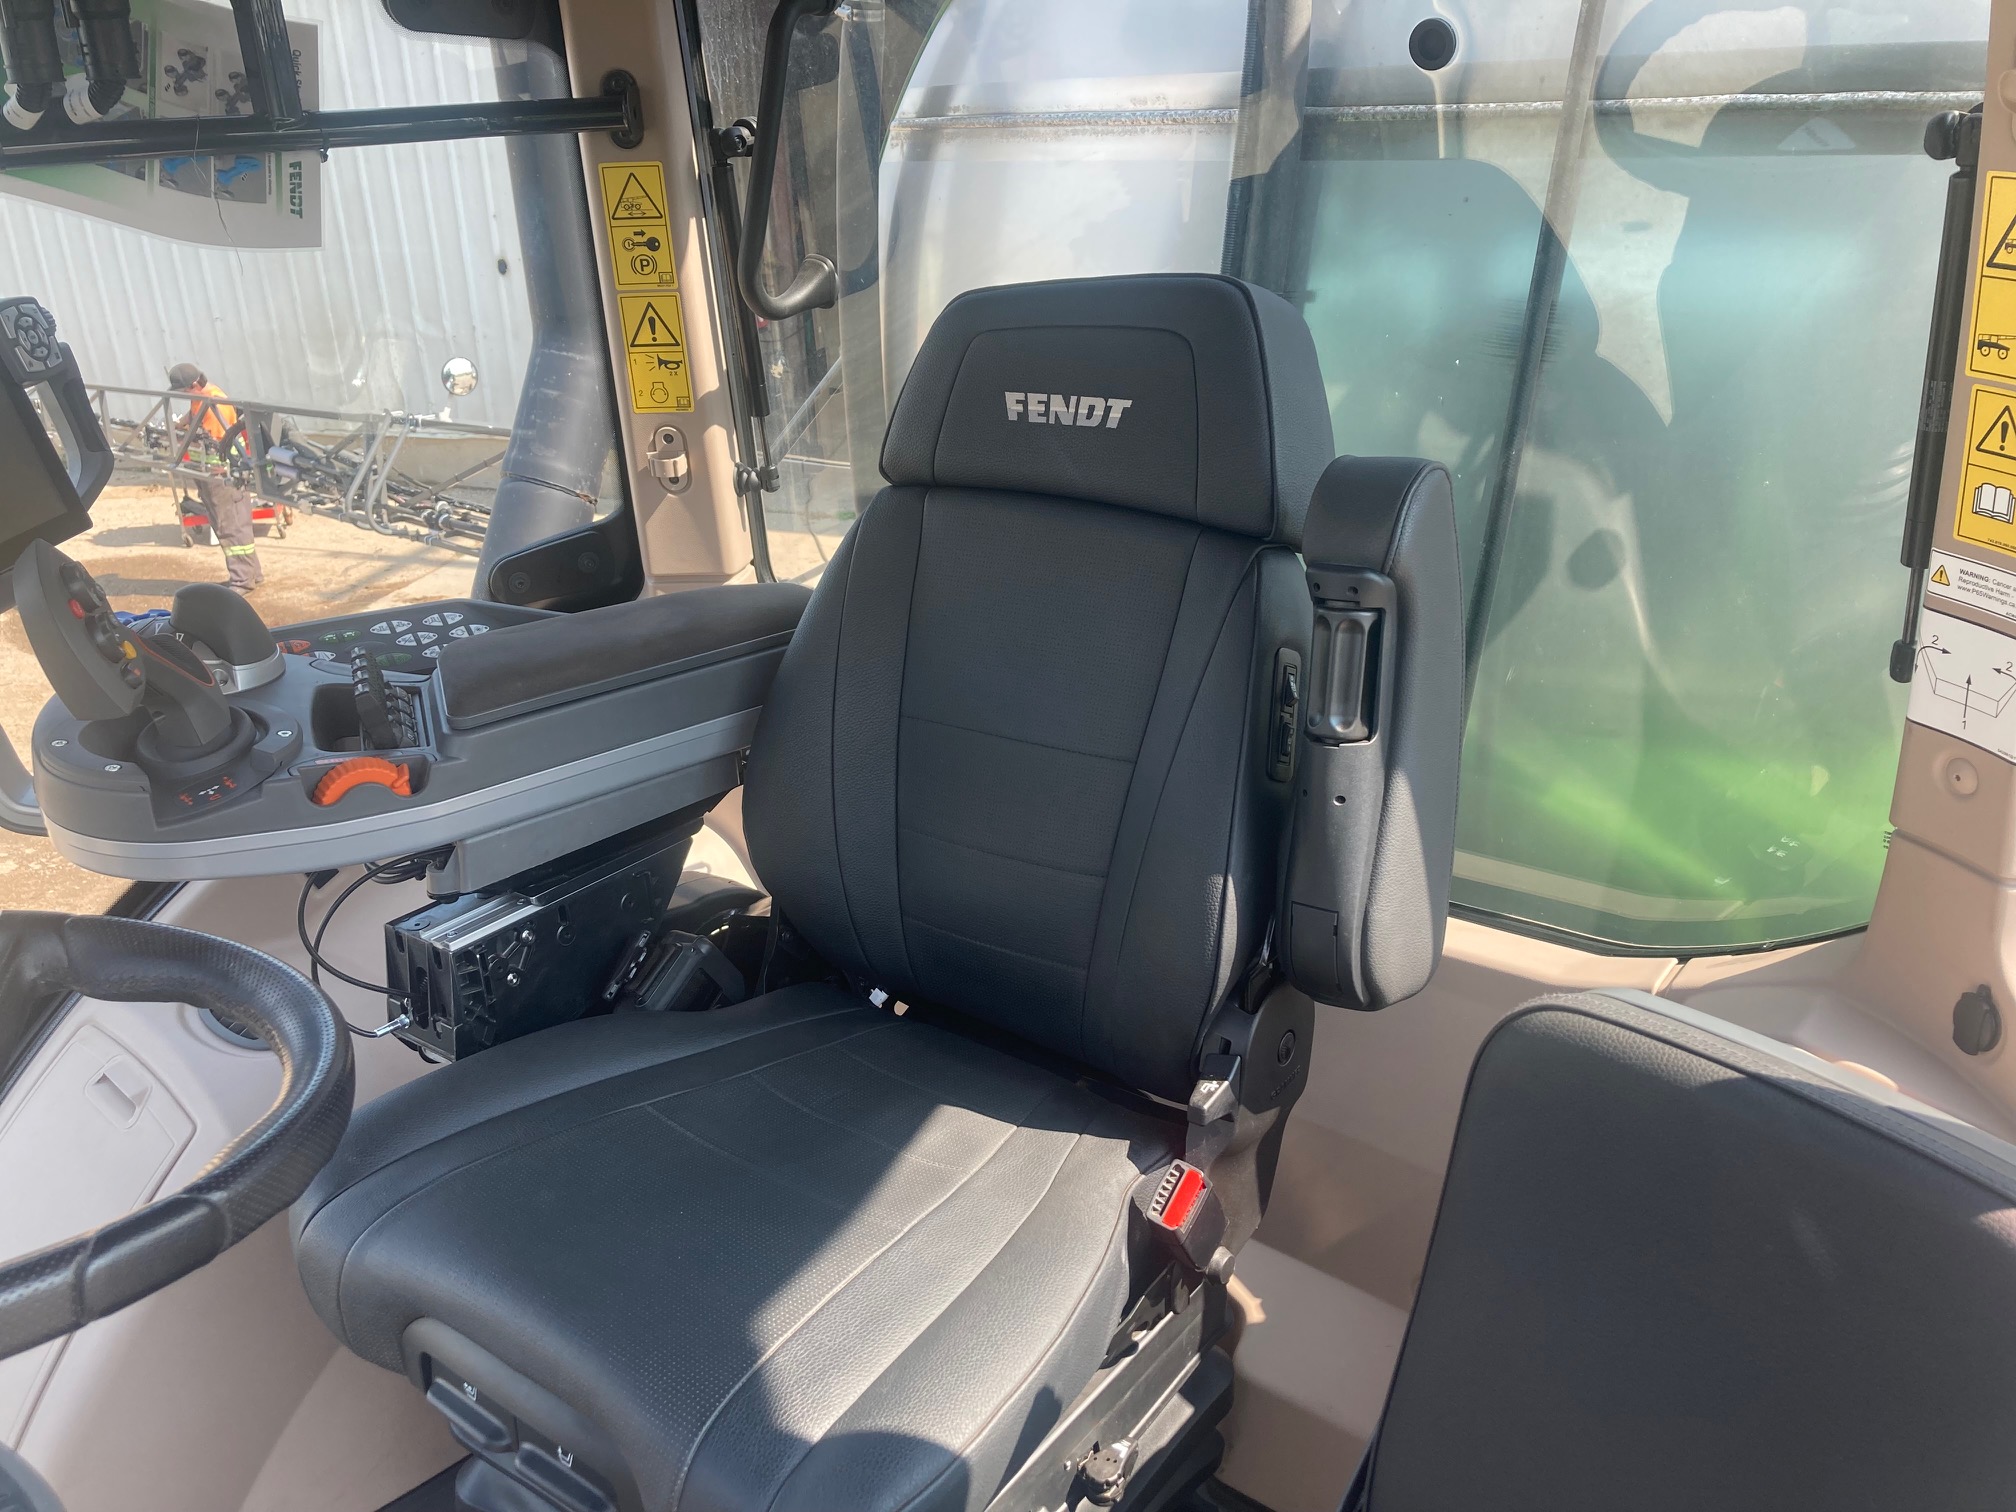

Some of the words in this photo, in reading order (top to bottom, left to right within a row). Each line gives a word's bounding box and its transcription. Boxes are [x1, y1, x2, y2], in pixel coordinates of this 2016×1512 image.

[289, 160, 303, 219] FENDT
[1004, 391, 1133, 429] FENDT
[1958, 576, 1994, 593] Reproductive
[1995, 588, 2010, 598] Harm
[1959, 568, 1991, 583] WARNING:
[1992, 578, 2012, 591] Cancer
[1931, 634, 1939, 645] 2
[2005, 661, 2013, 672] 2
[1962, 720, 1967, 730] 1
